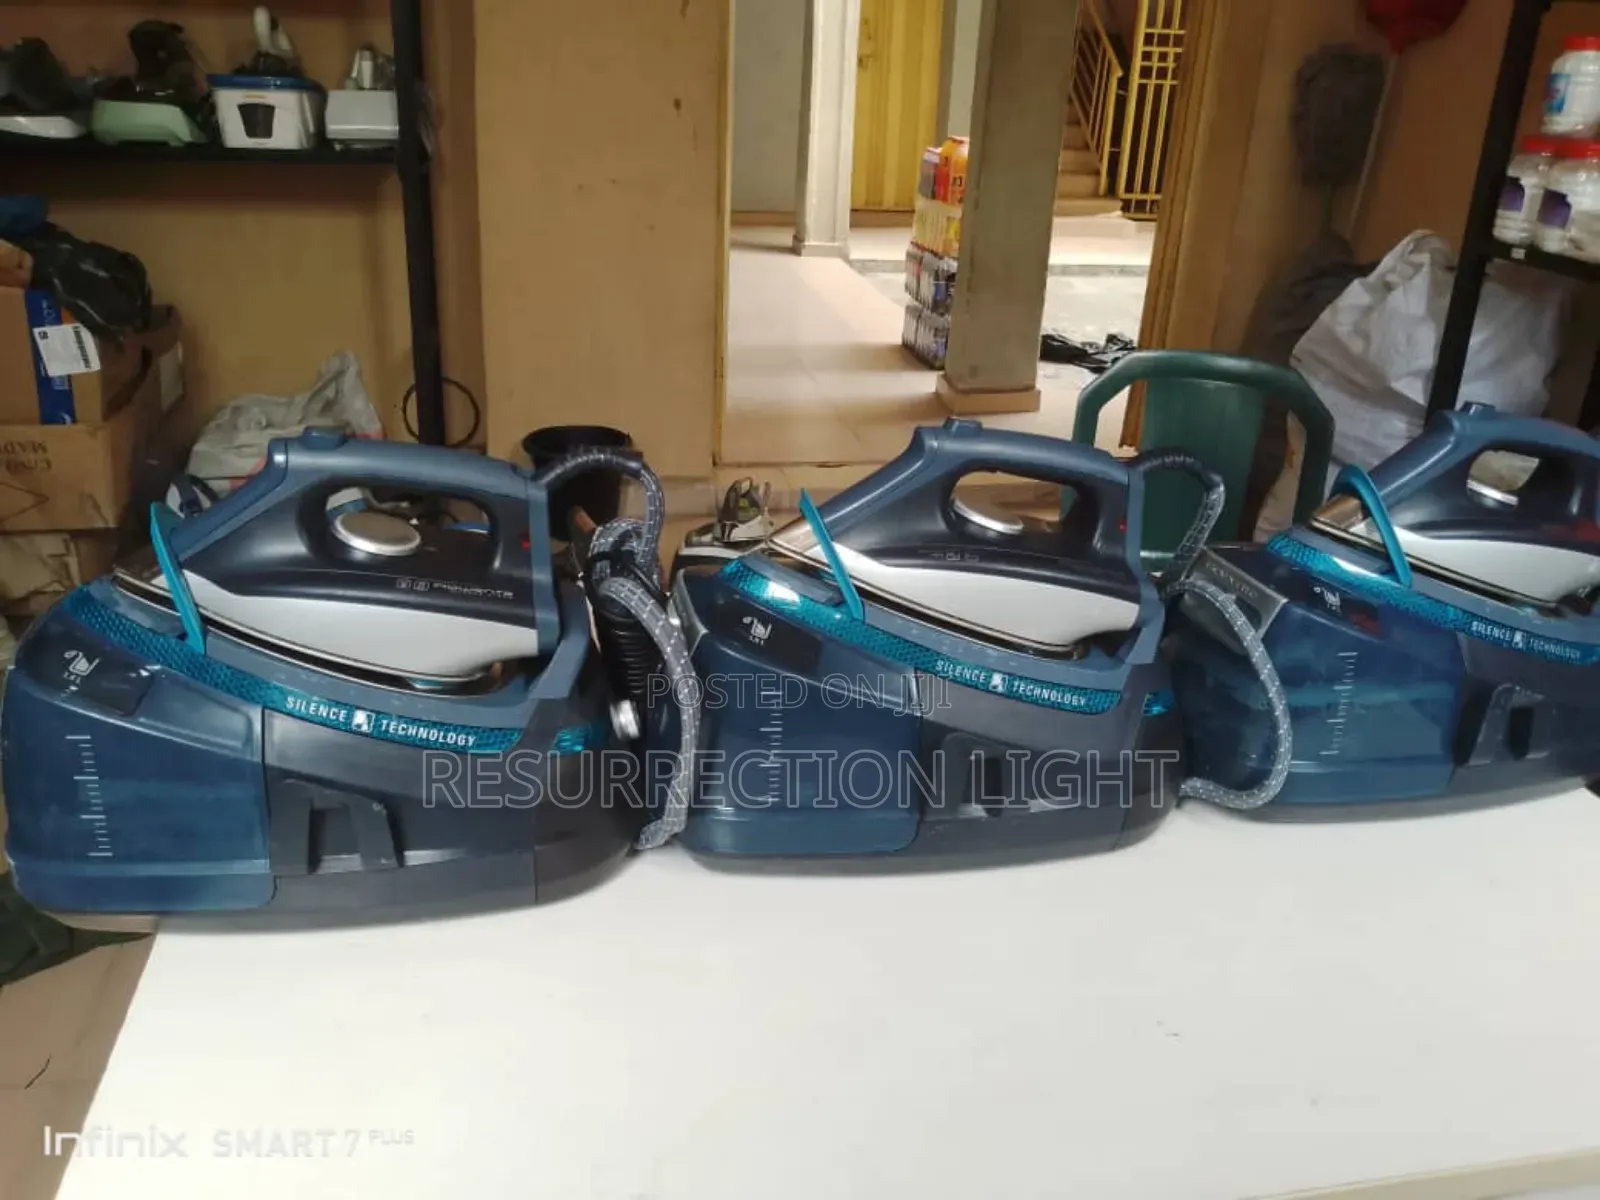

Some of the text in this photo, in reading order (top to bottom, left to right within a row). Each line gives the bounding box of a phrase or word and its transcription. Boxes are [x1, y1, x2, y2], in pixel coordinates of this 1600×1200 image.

[1471, 621, 1511, 641] SILENCE
[935, 659, 1087, 706] SILENCE TECHNOLOGY
[285, 696, 477, 747] SILENCE TECHNOLOGY
